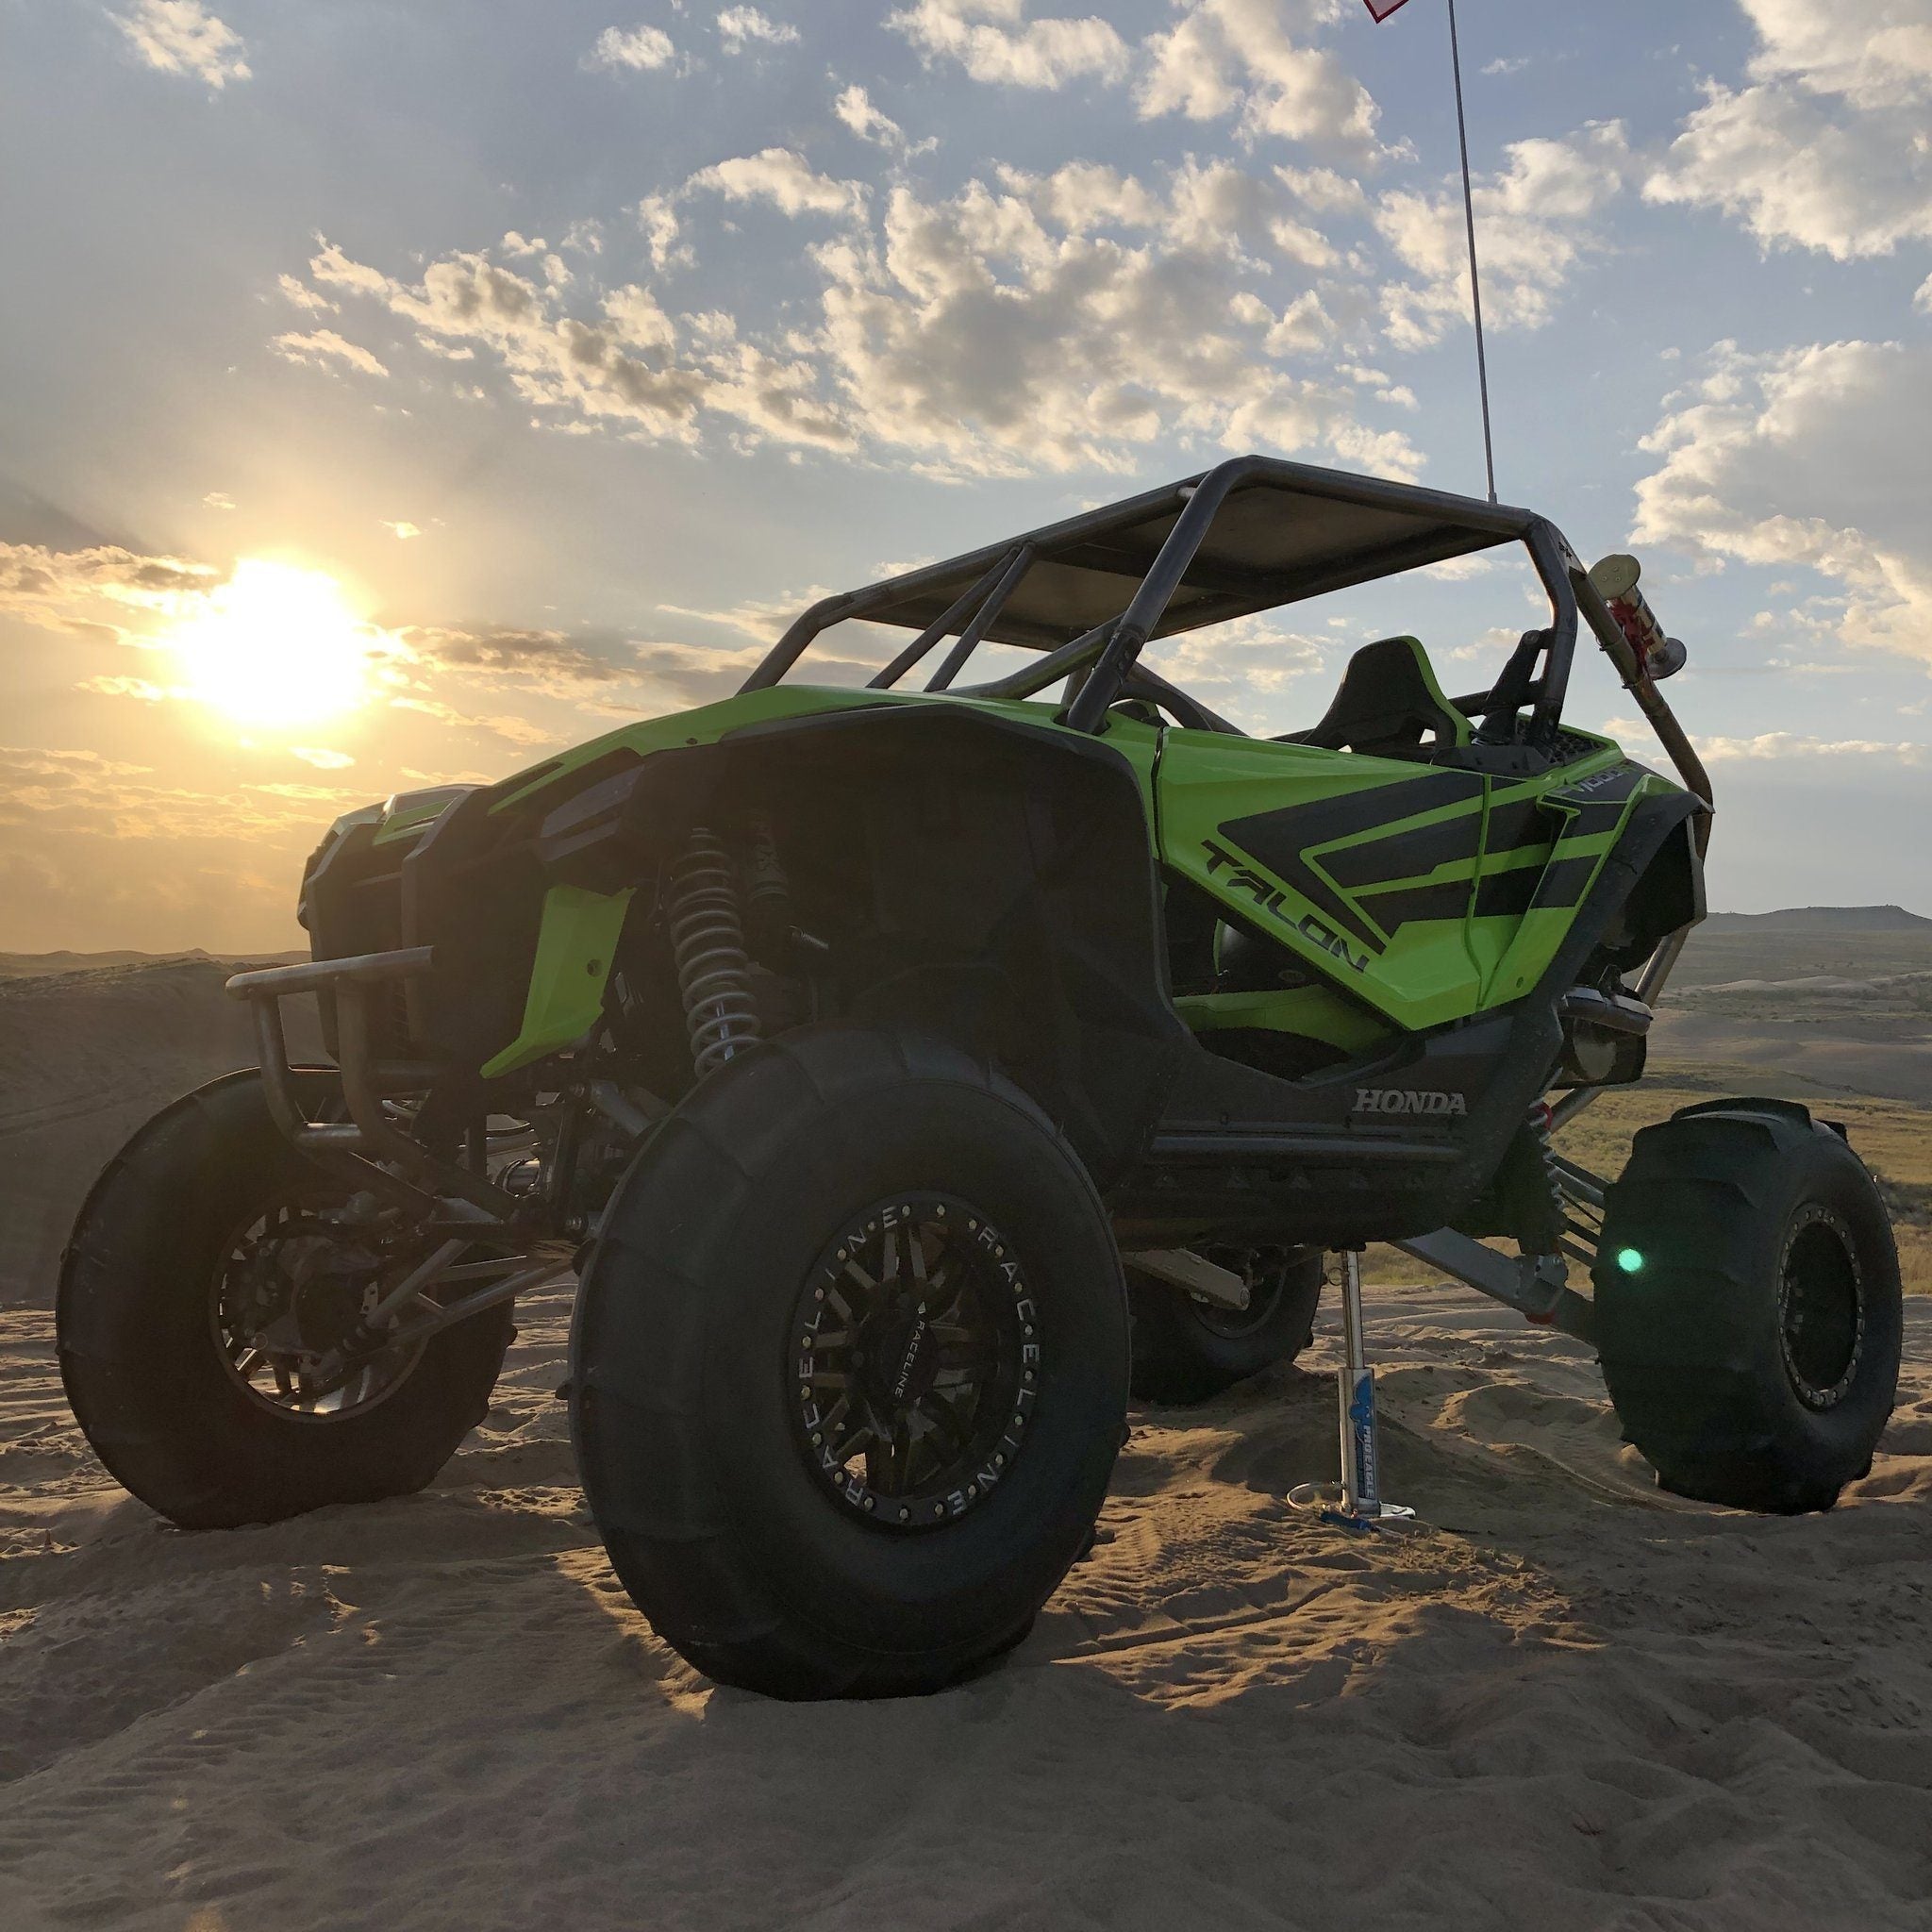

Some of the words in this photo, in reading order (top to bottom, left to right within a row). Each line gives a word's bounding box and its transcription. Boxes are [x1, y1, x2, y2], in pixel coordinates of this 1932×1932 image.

[1201, 839, 1370, 973] TALON
[1351, 1088, 1468, 1115] HONDA
[799, 1206, 897, 1507] RACELINE
[894, 1320, 926, 1399] RACELINE
[947, 1227, 1041, 1515] RACELINE
[1363, 1424, 1373, 1454] PRO
